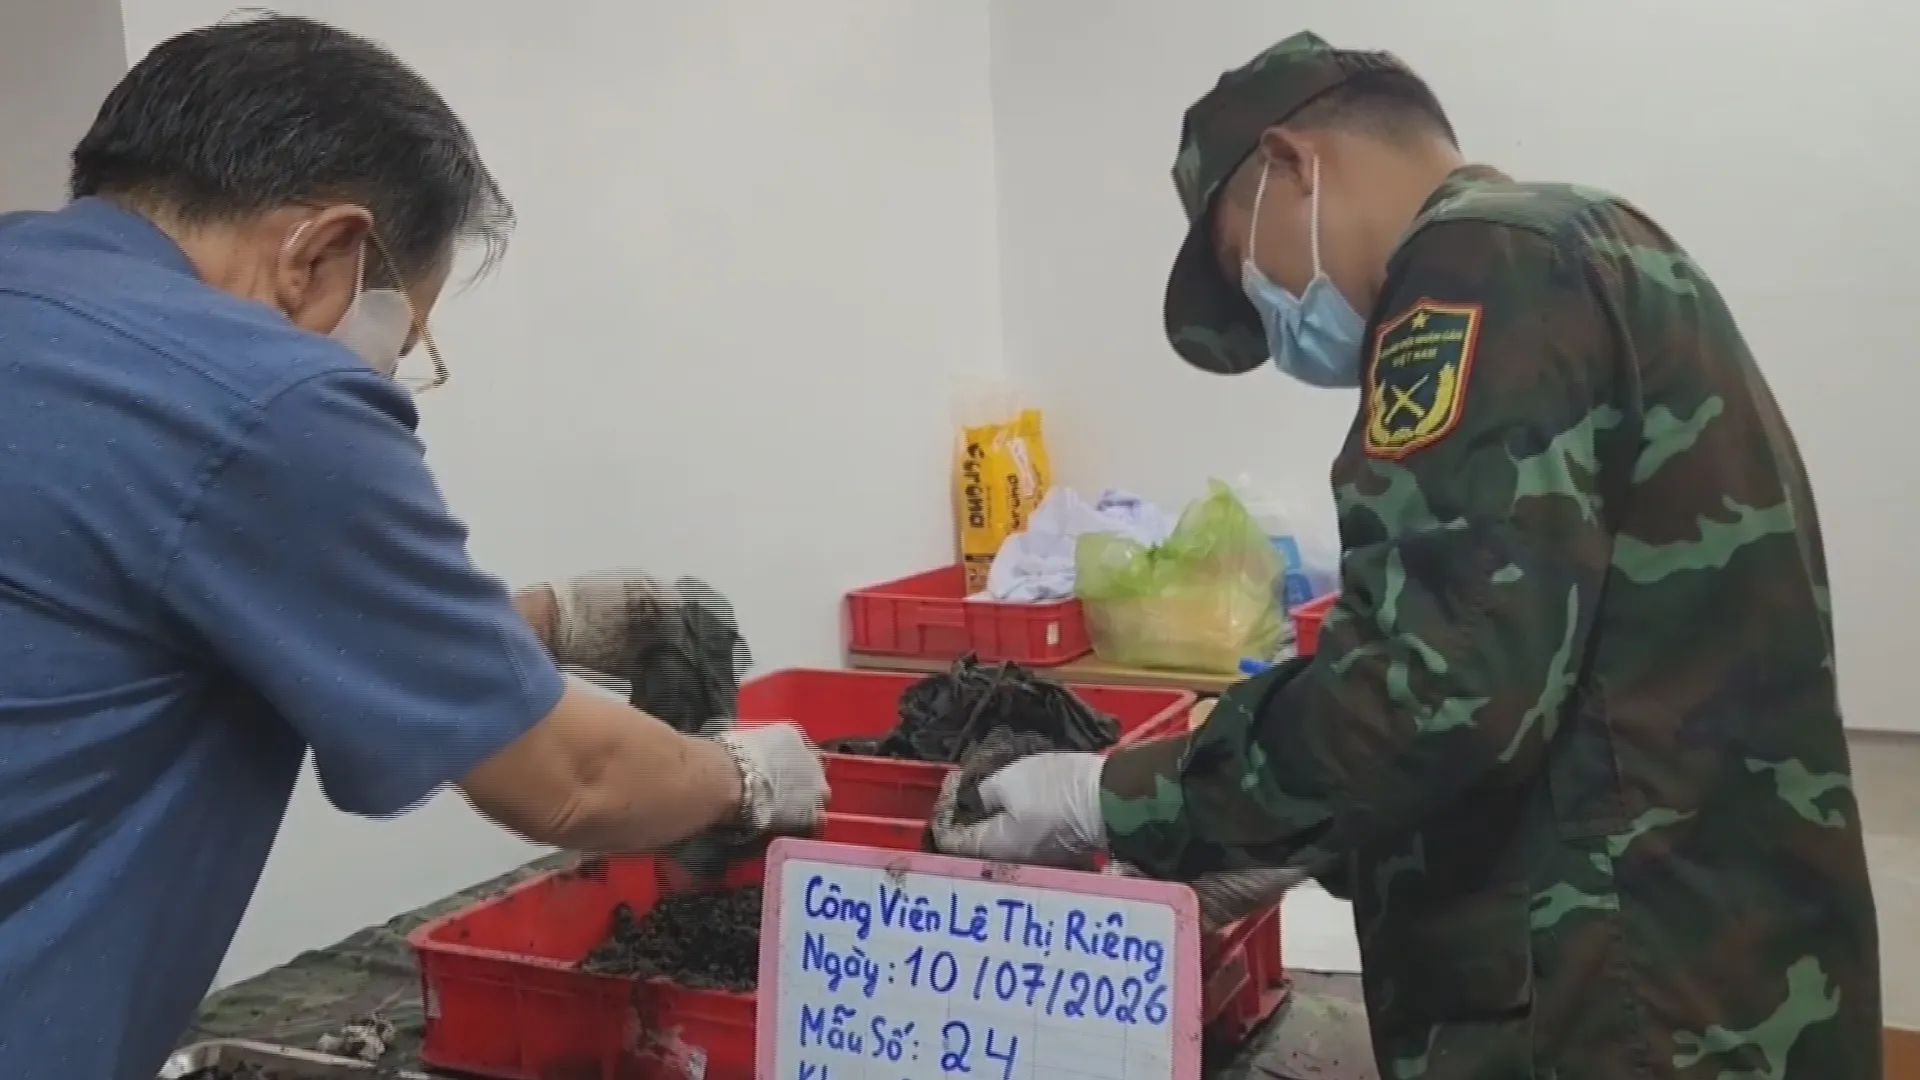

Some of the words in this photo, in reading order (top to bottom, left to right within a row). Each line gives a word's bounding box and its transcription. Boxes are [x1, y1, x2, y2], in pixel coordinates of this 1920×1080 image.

[805, 875, 872, 940] Công
[878, 884, 942, 933] Viên
[949, 894, 989, 943] Lê
[996, 899, 1054, 958] Thị
[1065, 909, 1165, 983] Riêng
[800, 1004, 863, 1054] Mẫu
[940, 1020, 1018, 1080] 24
